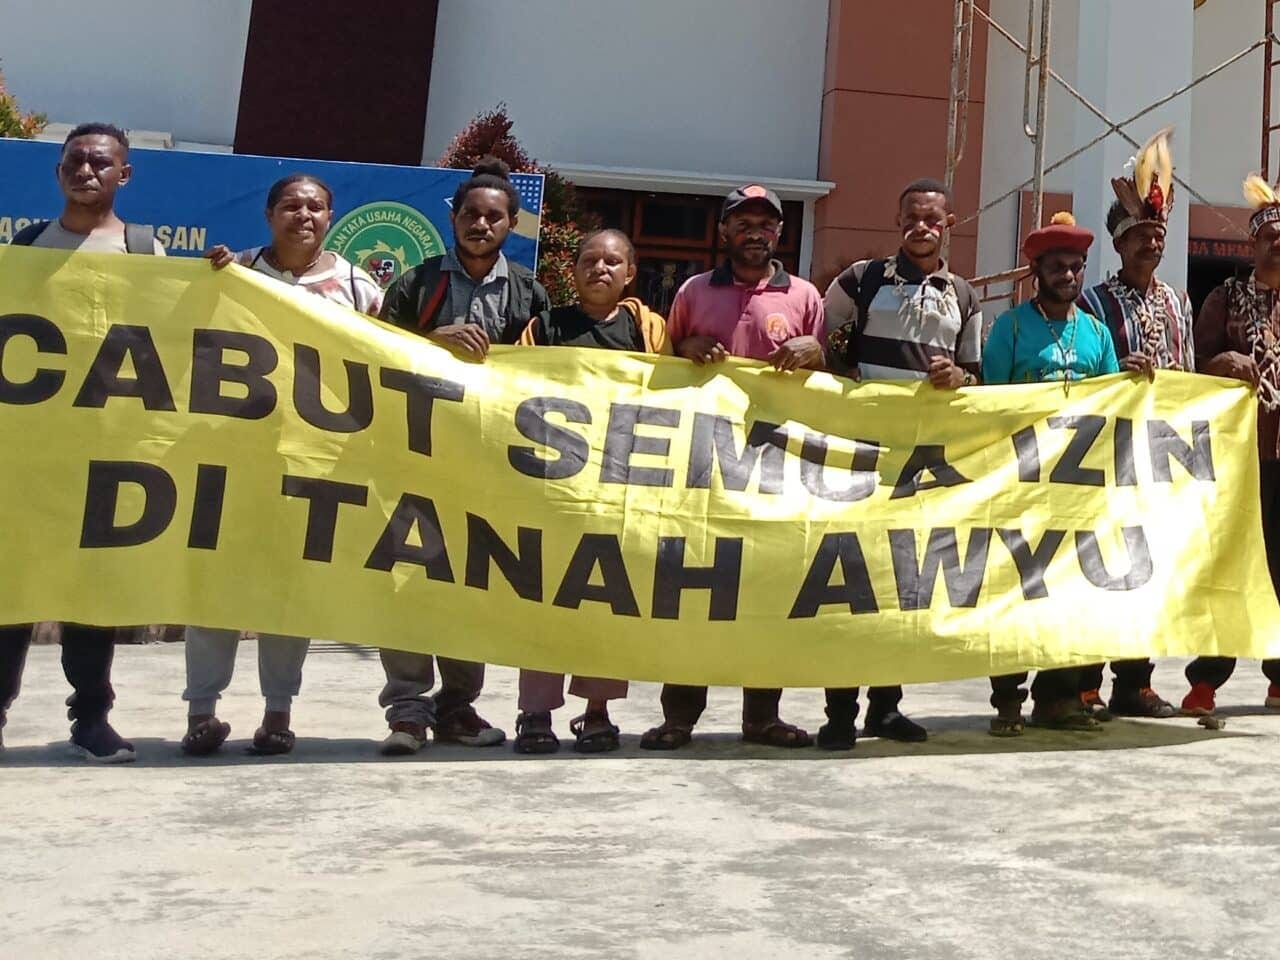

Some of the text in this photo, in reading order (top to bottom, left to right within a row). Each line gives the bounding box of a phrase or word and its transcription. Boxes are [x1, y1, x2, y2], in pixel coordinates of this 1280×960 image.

[343, 217, 367, 235] TATA
[366, 211, 401, 222] USAHA
[402, 216, 433, 249] NEGARA
[0, 314, 1216, 503] CABUT SEMUA IZIN
[79, 460, 1154, 621] DI TANAH AWYU
